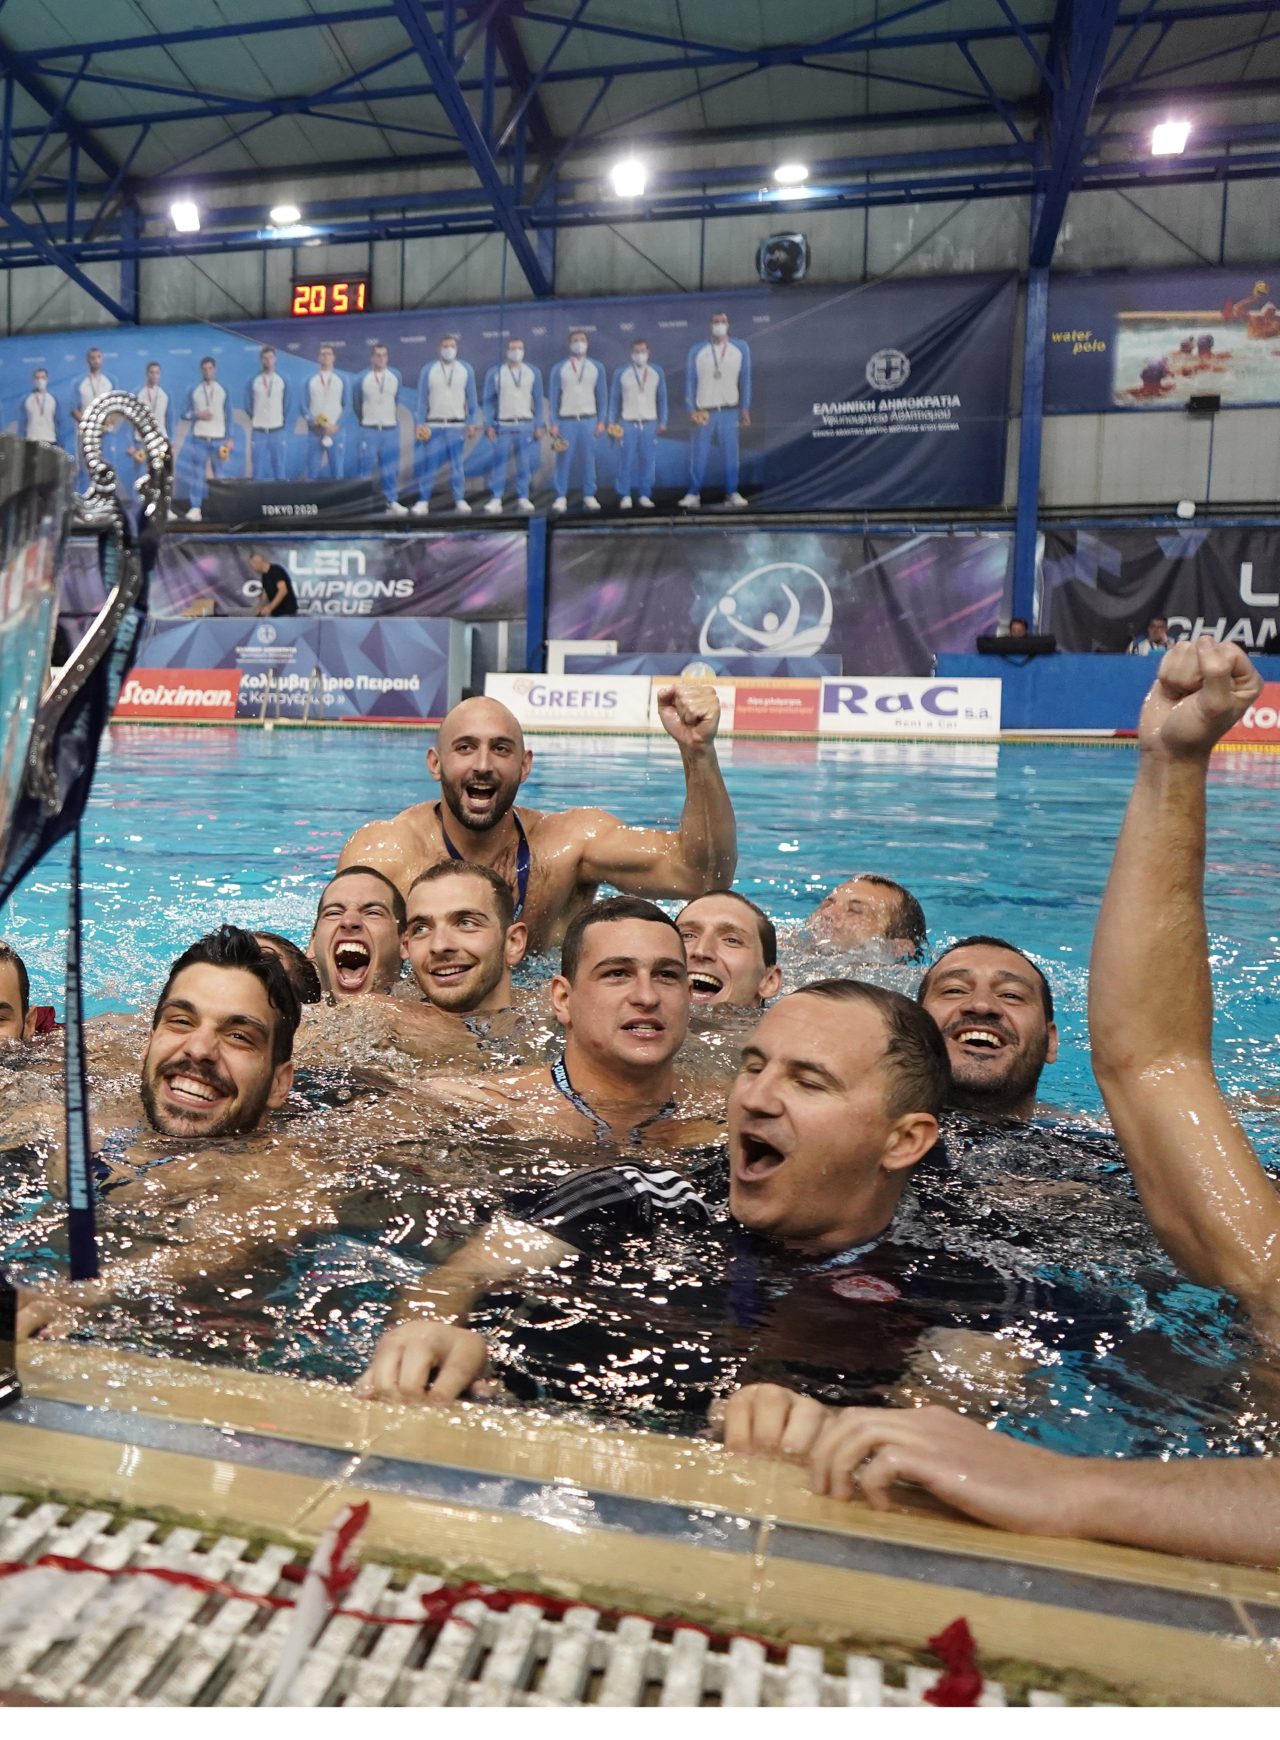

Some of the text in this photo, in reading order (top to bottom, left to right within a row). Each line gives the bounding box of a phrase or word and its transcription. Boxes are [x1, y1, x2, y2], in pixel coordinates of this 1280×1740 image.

[1052, 330, 1093, 343] water
[1072, 340, 1106, 355] polo
[813, 395, 961, 415] ΕΛΛΗΝΙΚΗ ΔΗΜΟΚΡΑΤΙΑ
[261, 503, 319, 516] TOKYO 2020
[288, 550, 367, 576] LEN
[242, 579, 415, 599] CMPIONS
[297, 600, 374, 615] EAGUE
[119, 680, 231, 707] Stoiximan
[356, 674, 420, 694] Πειραιά
